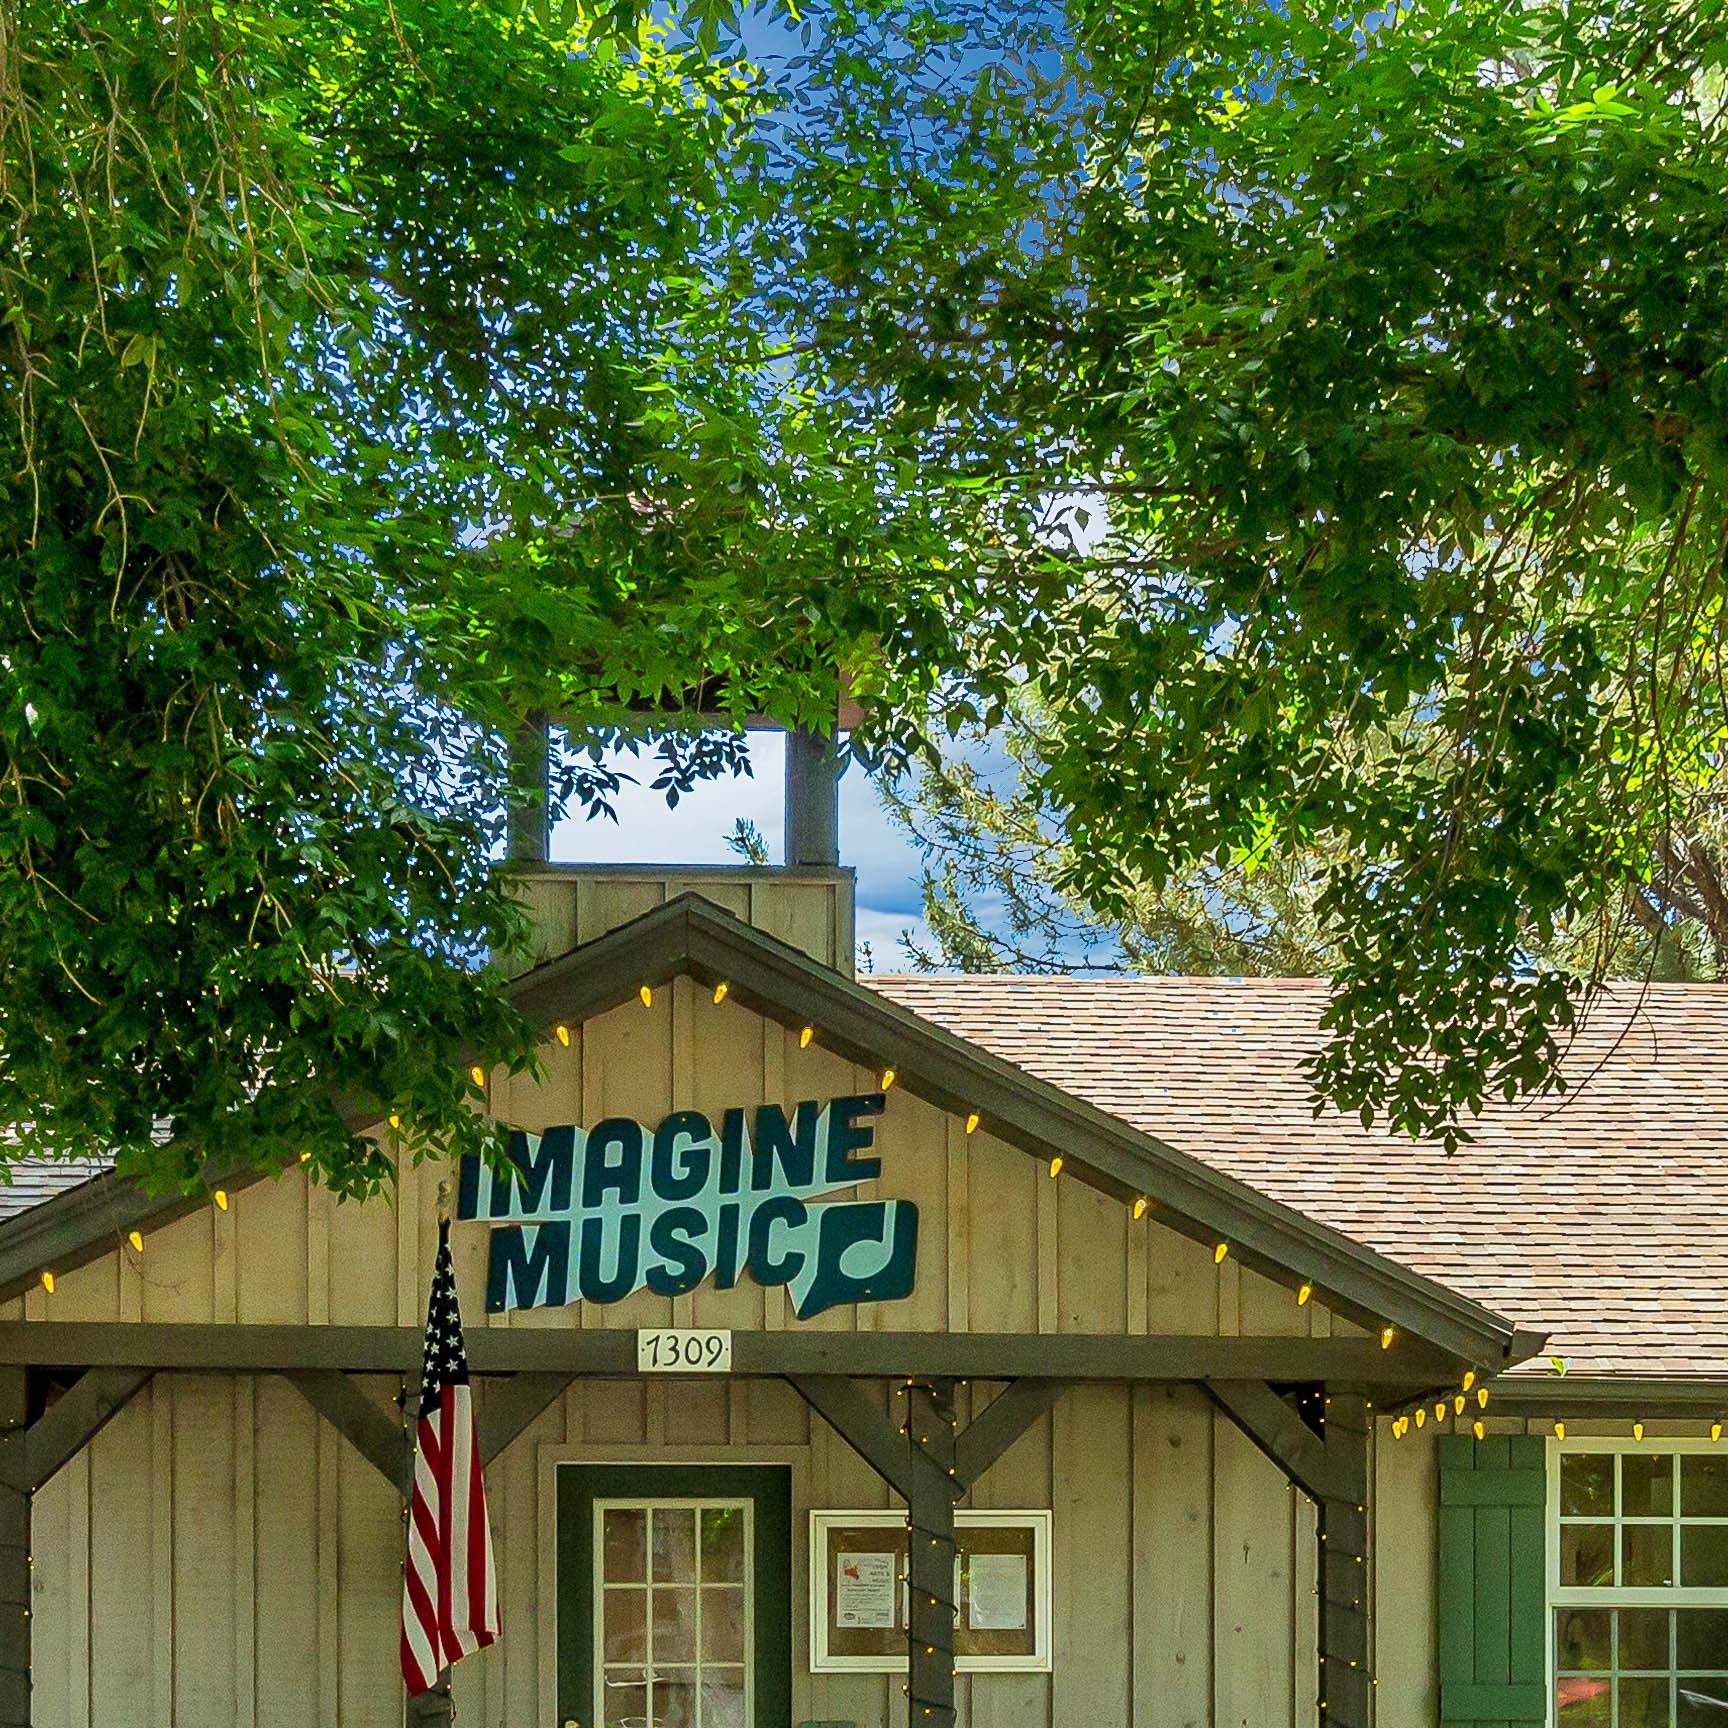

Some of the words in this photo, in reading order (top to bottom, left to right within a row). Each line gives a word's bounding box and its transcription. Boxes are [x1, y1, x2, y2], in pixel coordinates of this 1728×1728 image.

[458, 1093, 886, 1220] IMAGINE
[485, 1196, 808, 1314] MUSIC
[646, 1334, 723, 1368] 1309
